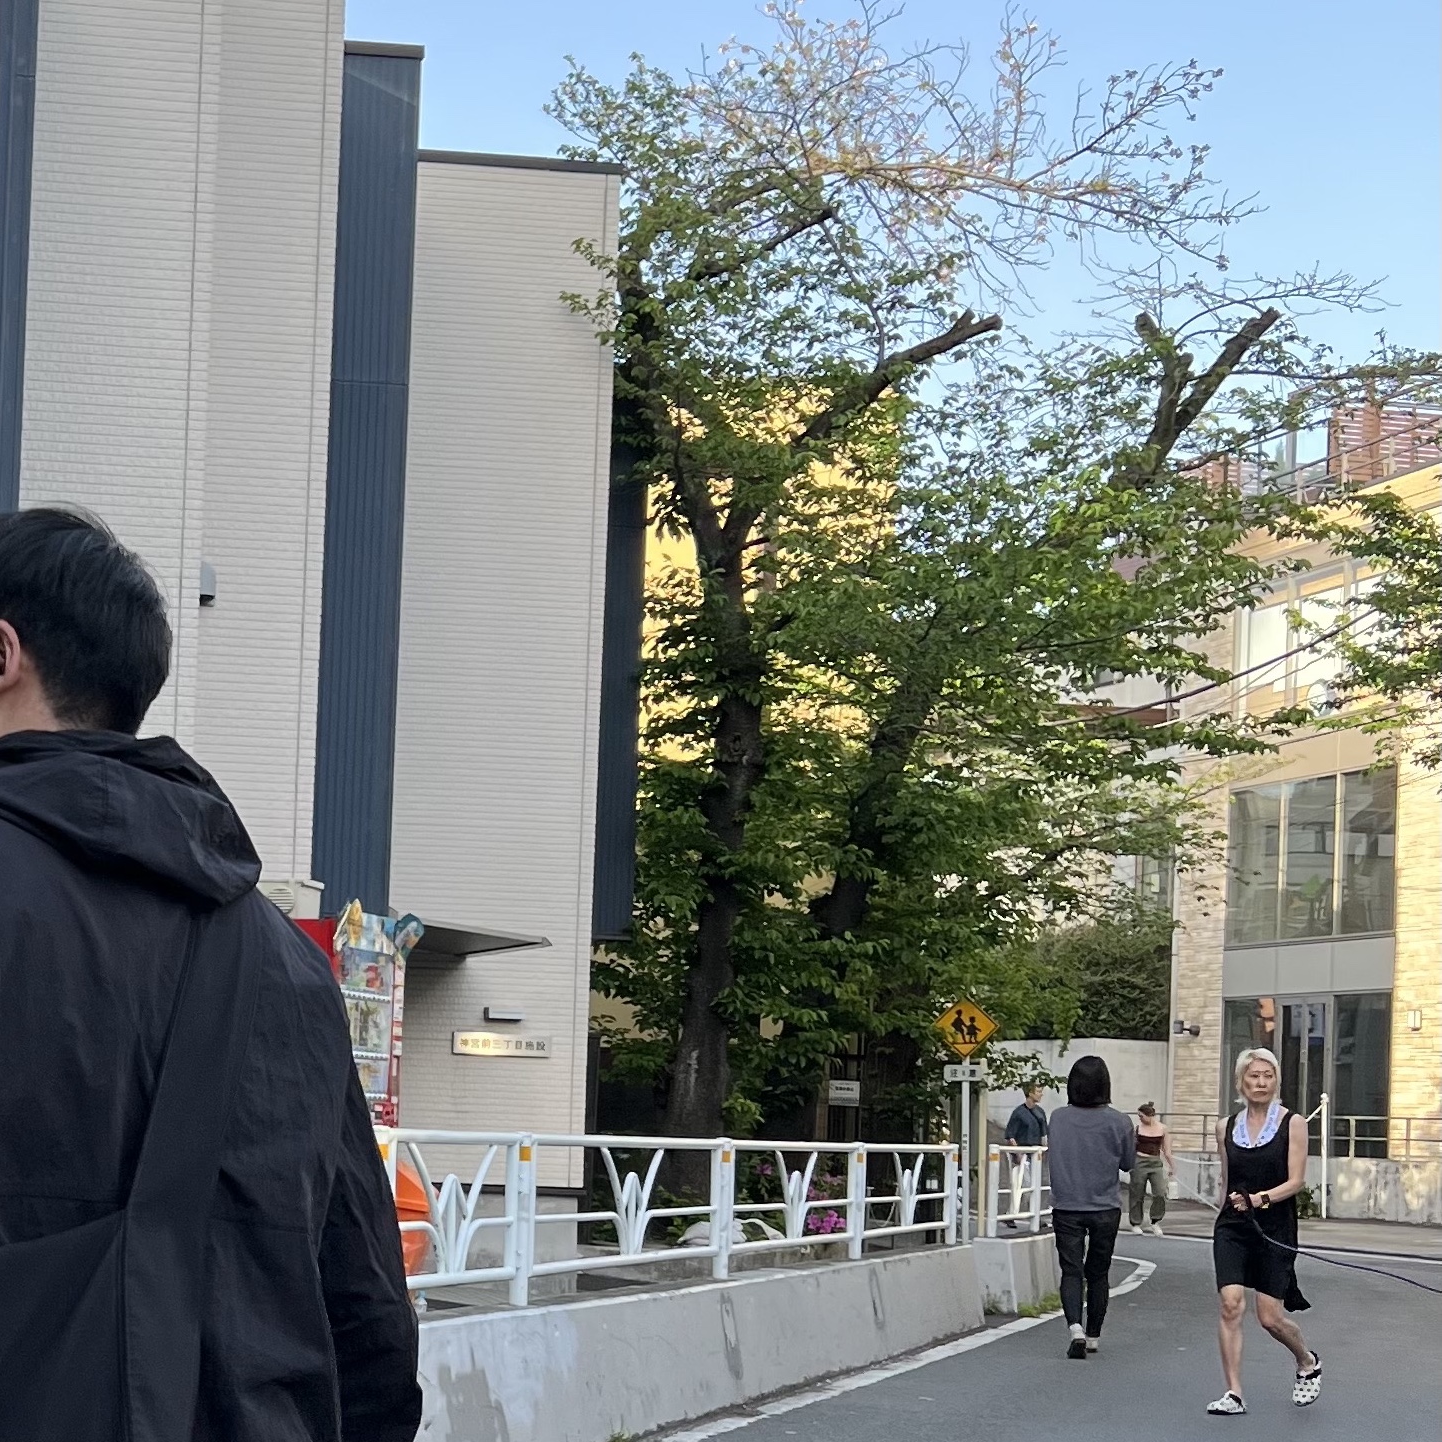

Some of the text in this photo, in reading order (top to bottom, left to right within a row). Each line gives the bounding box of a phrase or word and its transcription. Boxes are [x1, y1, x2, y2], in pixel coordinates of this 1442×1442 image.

[460, 1038, 546, 1052] 神宮前三丁目施設
